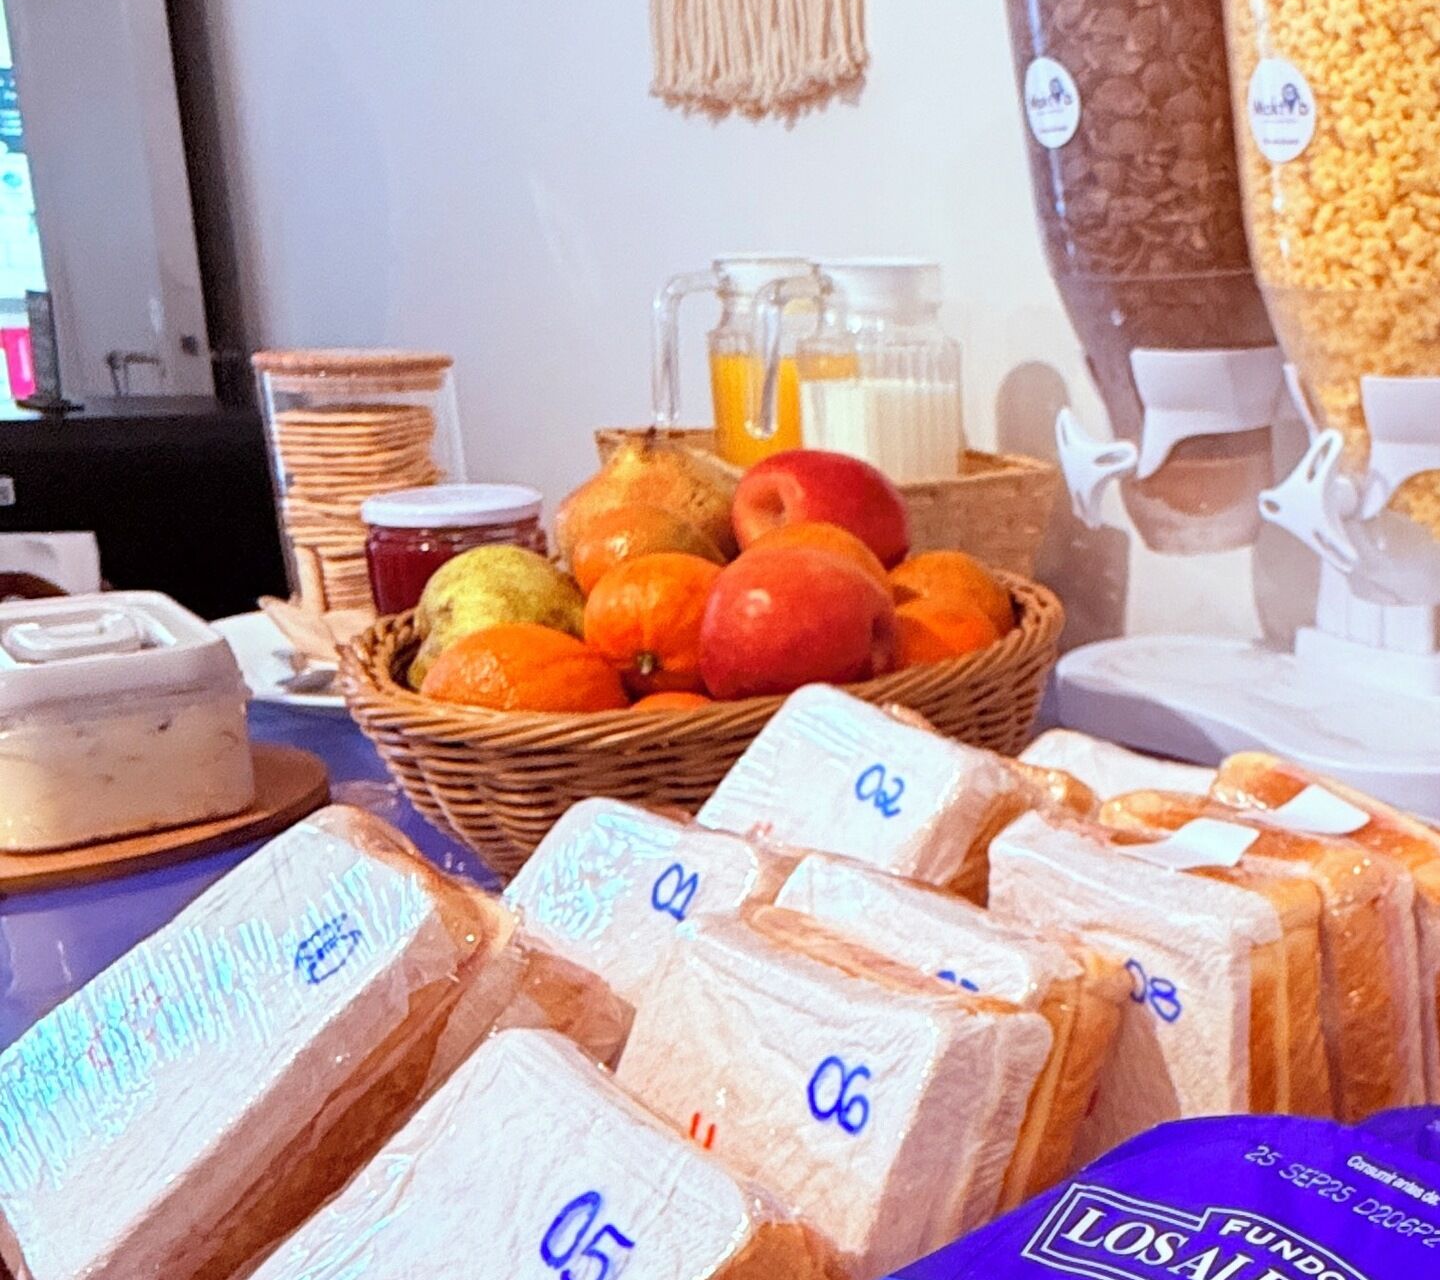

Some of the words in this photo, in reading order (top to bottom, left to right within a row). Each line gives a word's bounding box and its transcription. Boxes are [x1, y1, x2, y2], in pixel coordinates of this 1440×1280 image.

[1244, 1145, 1283, 1167] 25
[1278, 1162, 1356, 1203] SEP25
[1062, 1206, 1190, 1277] LOS
